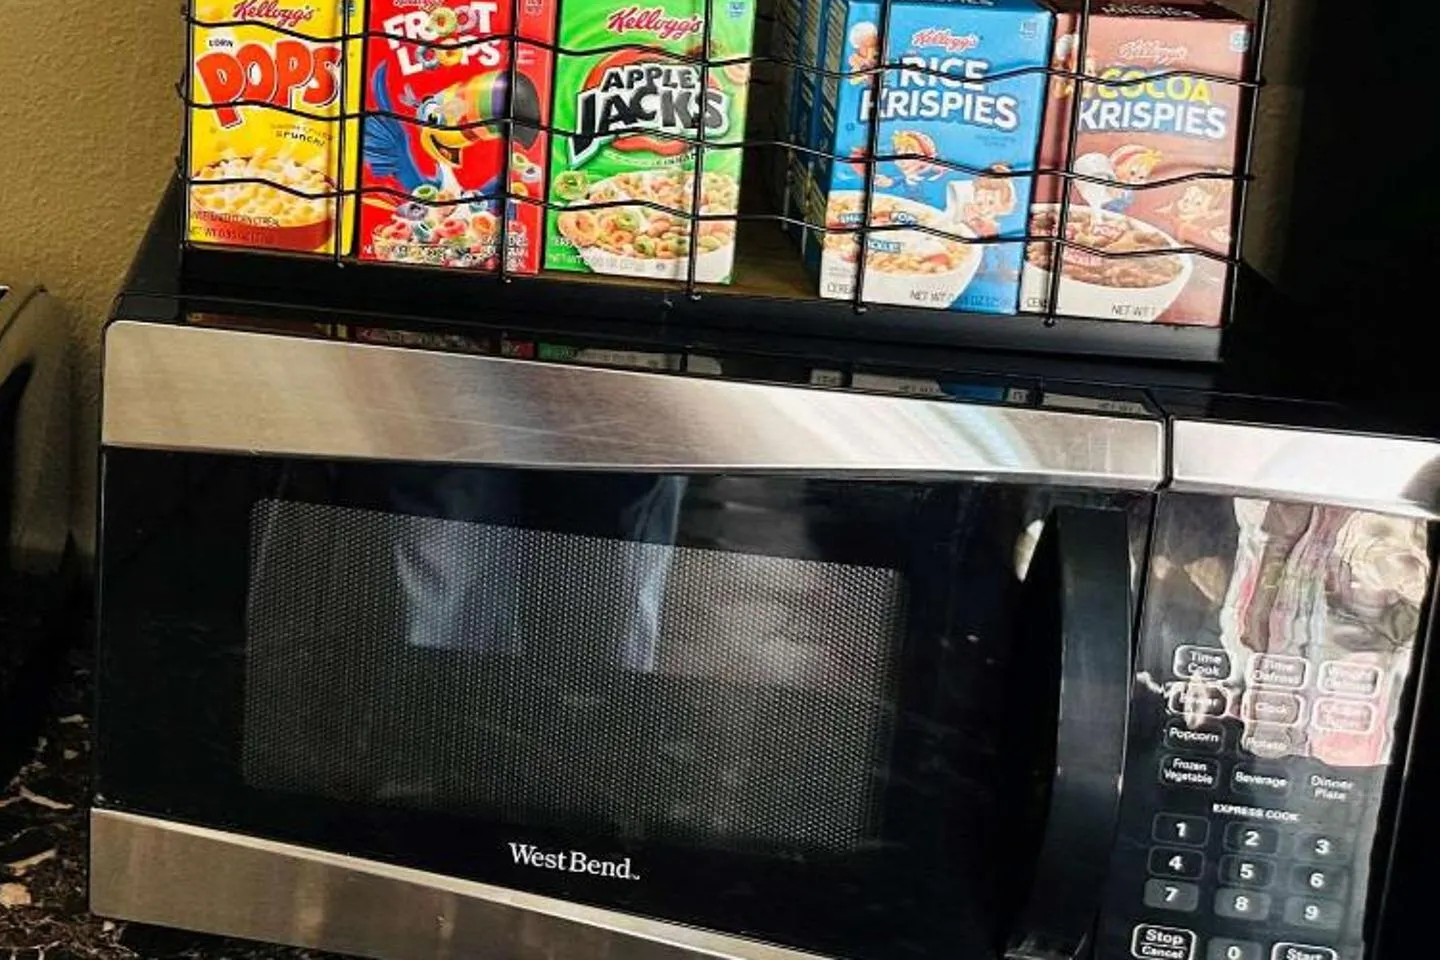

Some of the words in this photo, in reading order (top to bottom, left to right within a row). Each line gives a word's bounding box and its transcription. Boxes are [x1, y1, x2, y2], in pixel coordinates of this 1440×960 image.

[383, 1, 498, 50] FROOT
[608, 7, 703, 40] Kellogg's
[396, 34, 501, 76] LOOPS
[601, 66, 696, 92] APPLE
[900, 57, 989, 91] RICE
[195, 40, 342, 129] POPS
[1097, 67, 1212, 105] COCOA
[860, 90, 1018, 130] KRISPIES
[573, 87, 724, 156] JACKS
[1078, 100, 1227, 139] KRISPIES
[1189, 650, 1222, 665] Time
[1188, 662, 1221, 677] Cook
[1169, 727, 1220, 742] Popcorn
[1172, 758, 1207, 772] Frozen
[1163, 769, 1214, 785] Vegetable
[1235, 771, 1289, 788] Beverage
[1213, 803, 1264, 818] EXPRESS
[1176, 821, 1187, 837] 1
[1246, 831, 1260, 846] 2
[1315, 839, 1330, 855] 3
[508, 842, 567, 871] West
[568, 850, 631, 880] Bend
[1169, 855, 1183, 871] 4
[1240, 863, 1254, 879] 5
[1310, 872, 1325, 888] 6
[1165, 887, 1179, 902] 7
[1235, 896, 1249, 911] 8
[1305, 905, 1319, 921] 9
[1145, 928, 1184, 945] Stop
[1141, 945, 1185, 960] Cancel
[1228, 945, 1241, 960] 0
